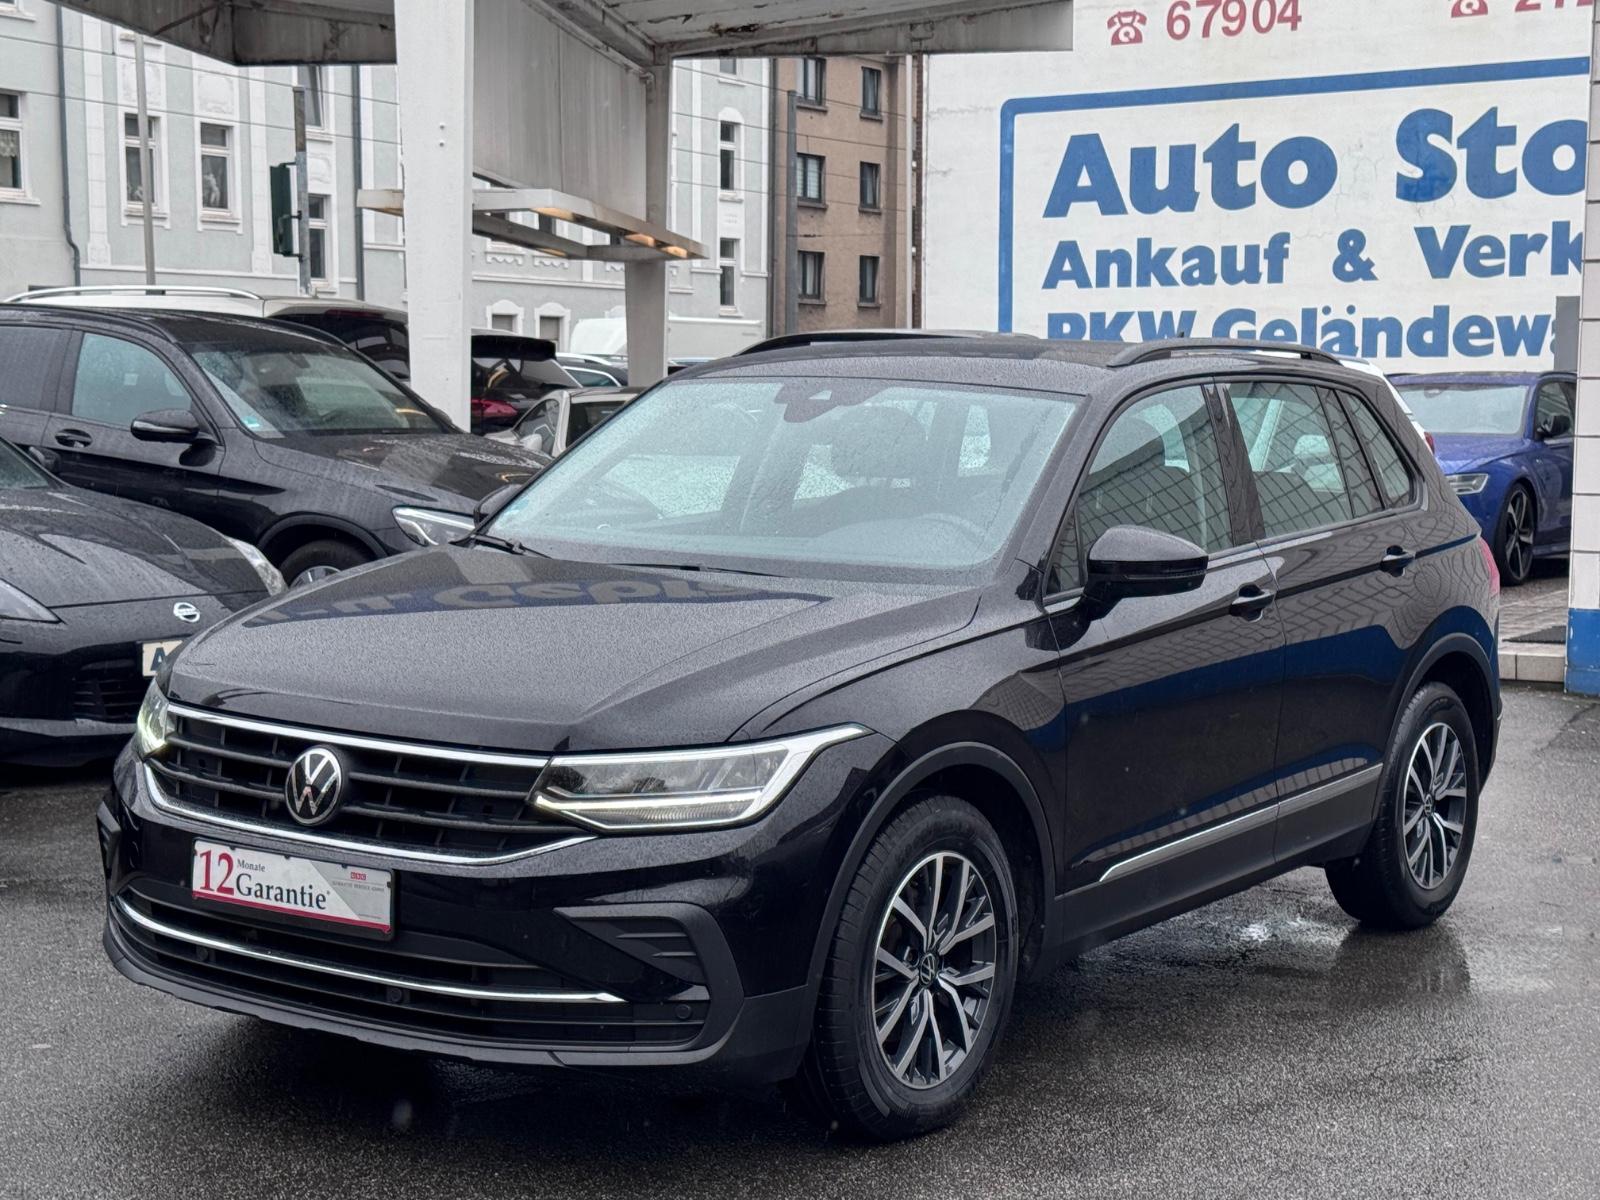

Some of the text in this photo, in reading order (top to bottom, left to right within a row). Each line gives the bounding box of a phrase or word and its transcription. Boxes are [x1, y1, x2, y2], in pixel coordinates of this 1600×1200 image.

[1166, 0, 1302, 40] 67904
[1042, 106, 1587, 218] Auto Sto
[1042, 220, 1583, 289] Ankauf & Verk
[1212, 304, 1556, 358] Geländew
[200, 850, 265, 896] 12 Monate
